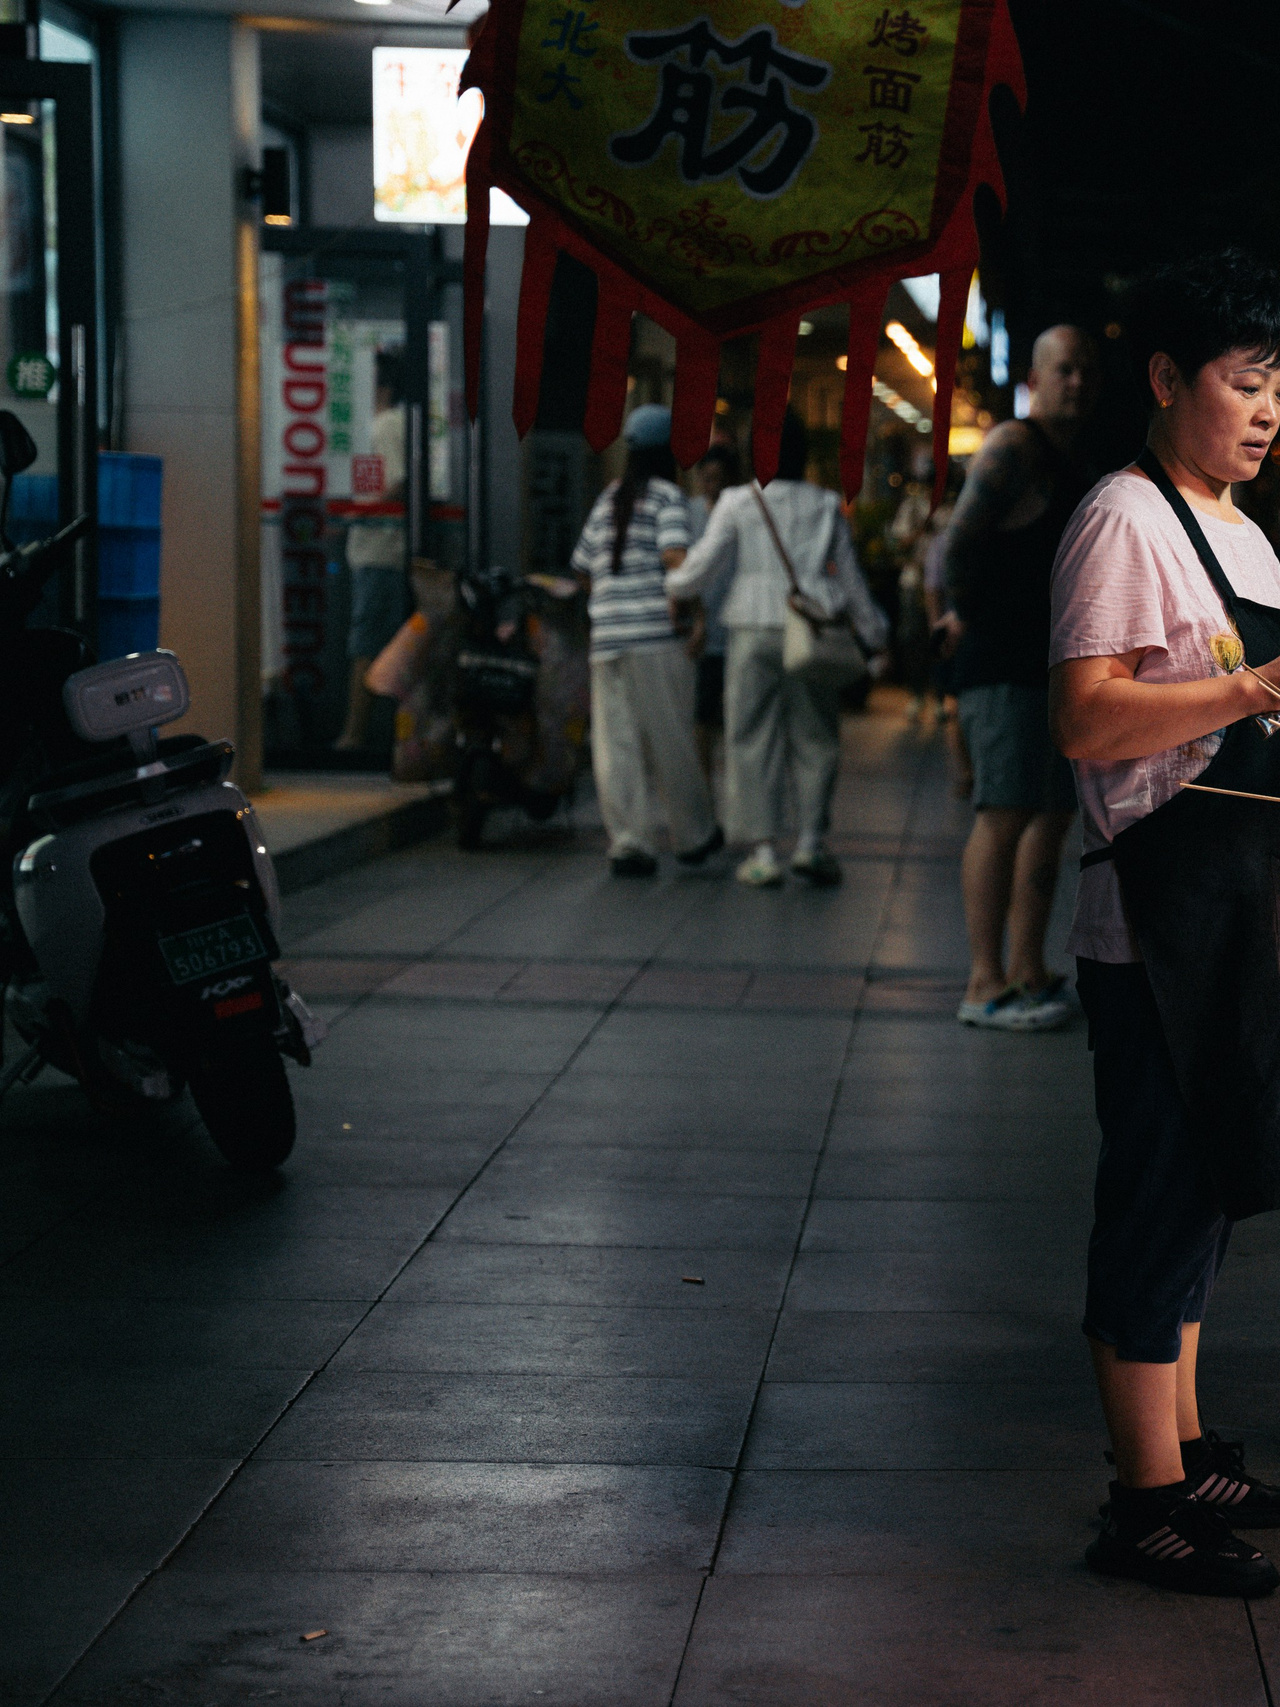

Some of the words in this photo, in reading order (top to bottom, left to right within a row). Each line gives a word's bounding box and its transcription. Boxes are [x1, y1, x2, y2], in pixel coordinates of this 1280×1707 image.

[609, 17, 832, 198] 筋
[855, 8, 927, 170] 烤面筋
